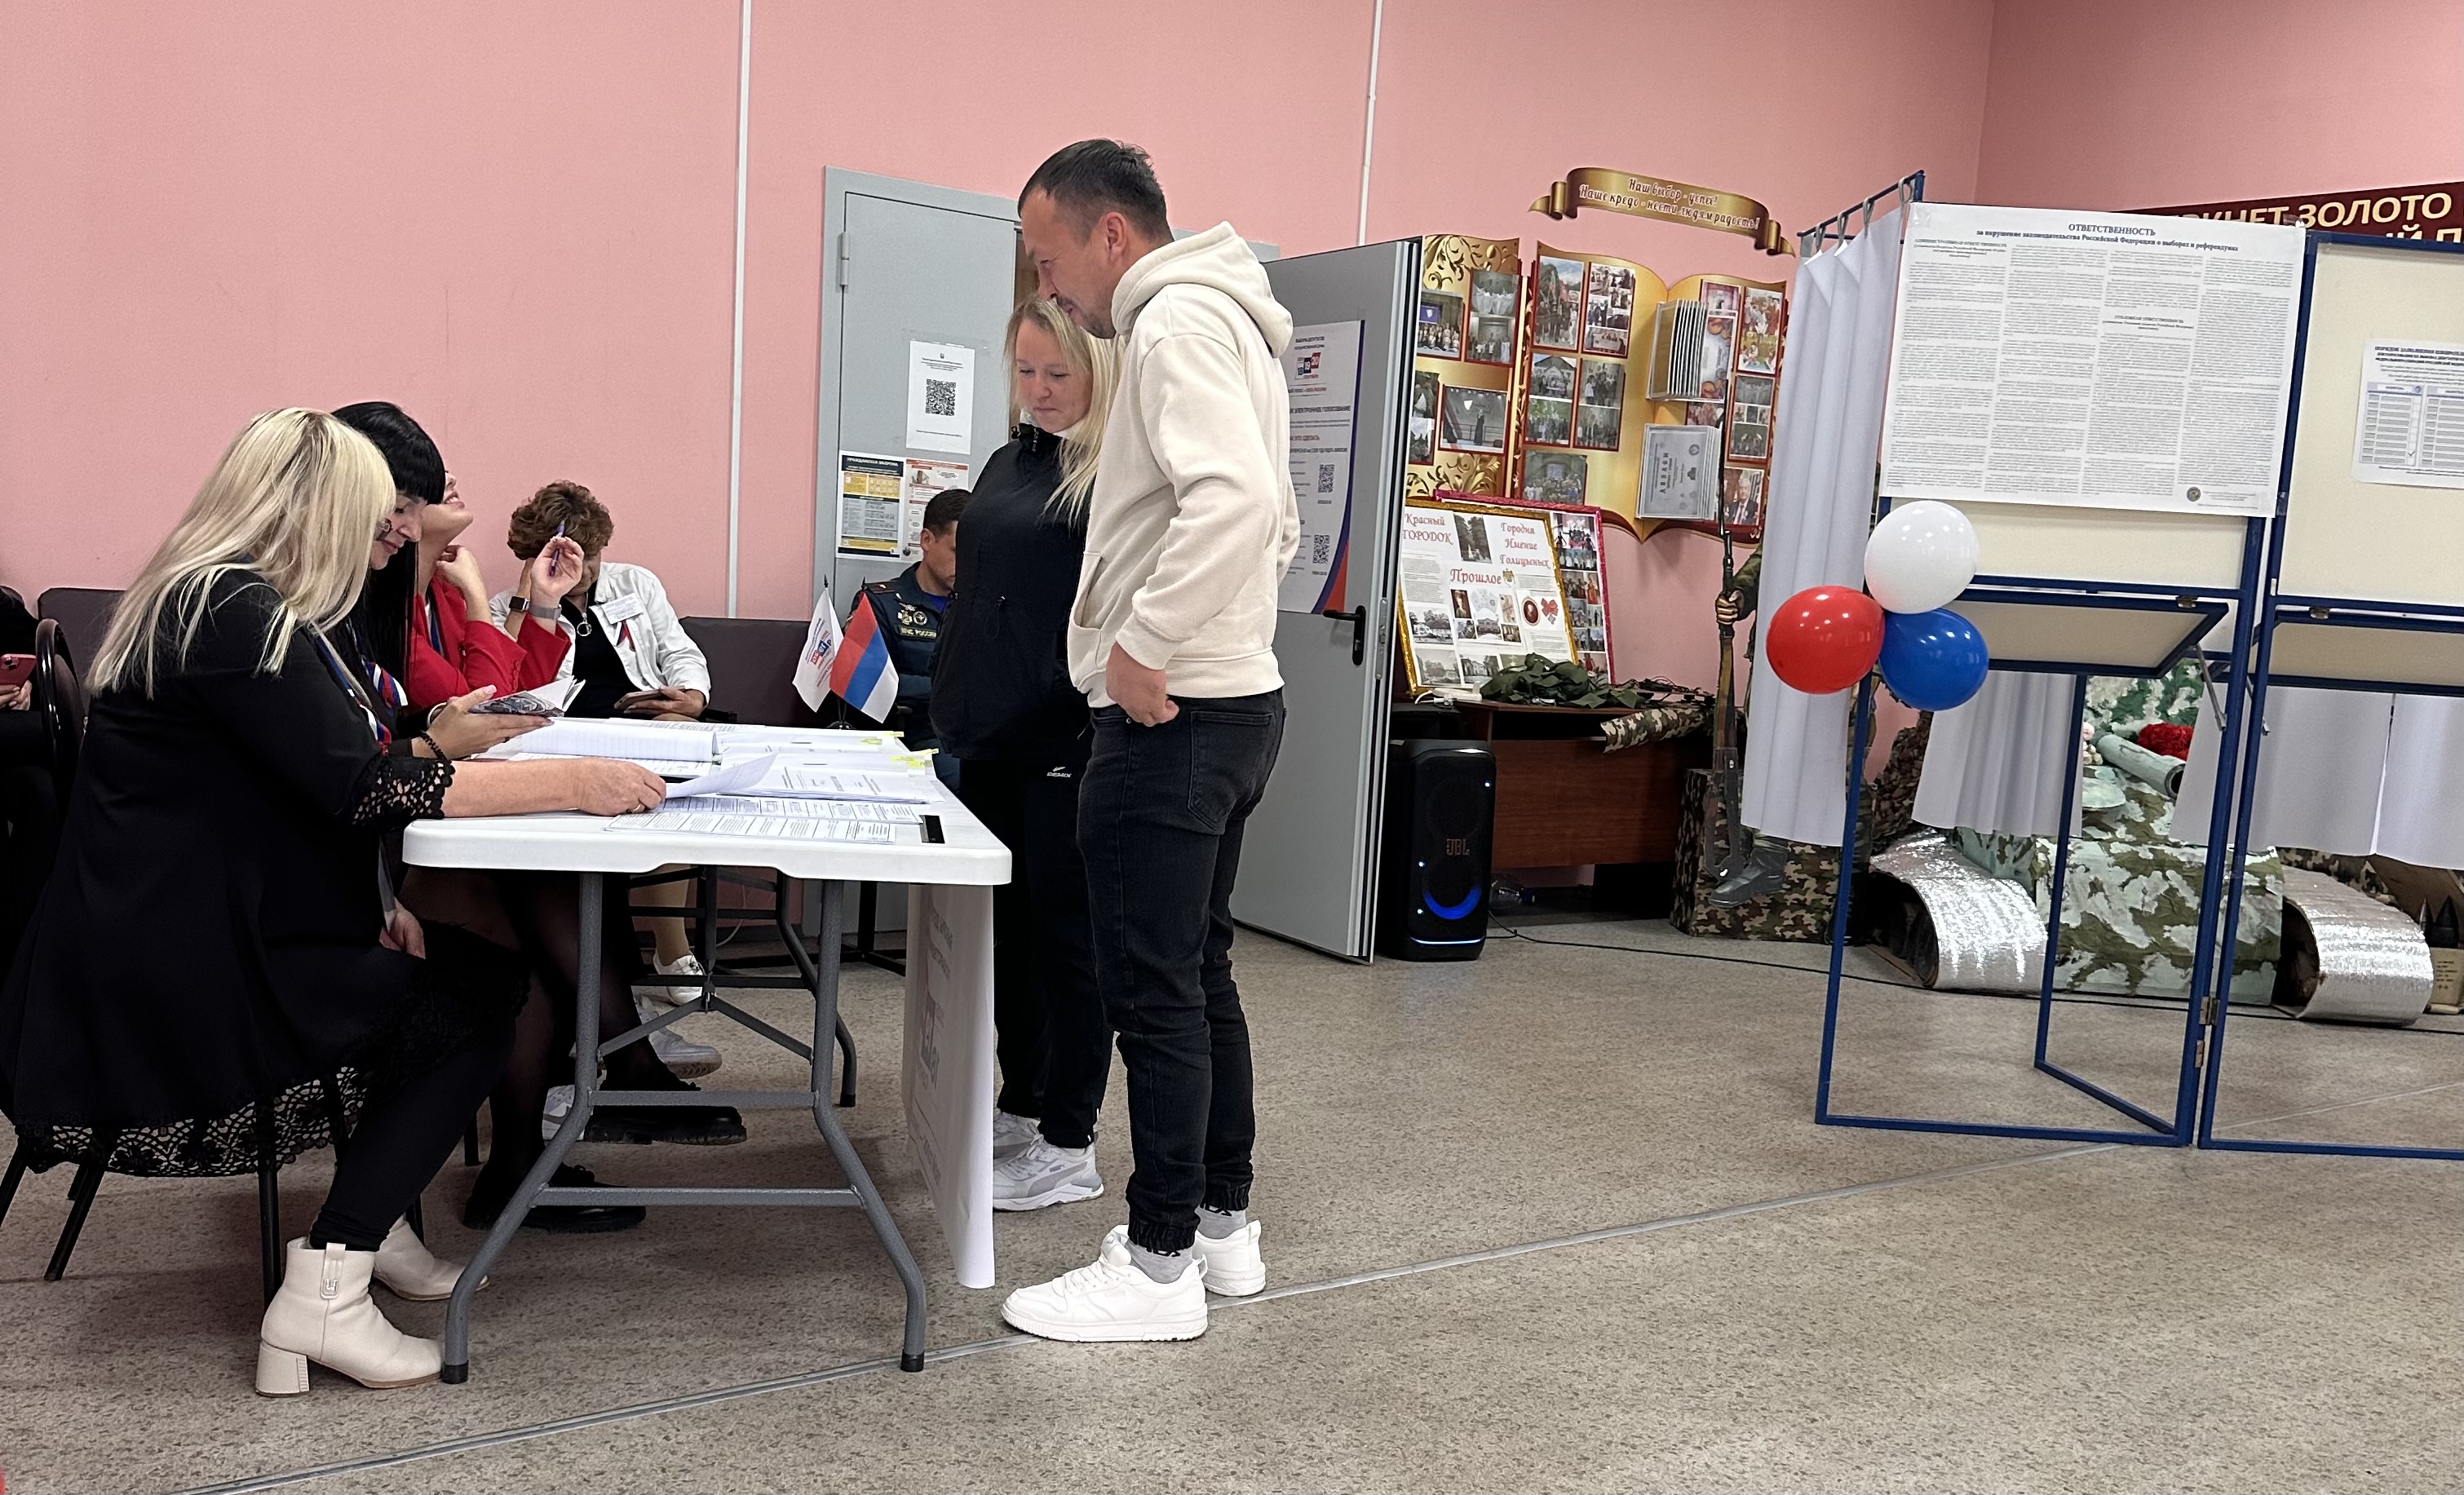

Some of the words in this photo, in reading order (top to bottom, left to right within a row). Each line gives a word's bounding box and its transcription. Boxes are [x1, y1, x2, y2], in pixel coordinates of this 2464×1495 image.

[1629, 177, 1650, 194] Наш
[1652, 181, 1682, 203] выбор
[1579, 184, 1608, 201] Наше
[1609, 194, 1639, 210] кредо
[1647, 200, 1677, 215] нести
[1679, 206, 1713, 223] людям
[1714, 212, 1760, 230] радость!
[2298, 192, 2452, 228] ЗОЛОТО
[2068, 223, 2156, 236] ОТВЕТСТВЕННОСТЬ
[2082, 234, 2118, 242] Российской
[2121, 237, 2156, 245] Федерации
[2162, 239, 2189, 247] выборах
[2196, 242, 2238, 251] референдумах
[1405, 513, 1445, 527] Красный
[1403, 529, 1453, 545] ГОРОДОК
[1501, 522, 1535, 536] Городня
[1505, 538, 1537, 550] Имение
[1500, 555, 1551, 569] Голицыных
[1450, 568, 1502, 585] Прошлое
[1446, 838, 1470, 856] JBL
